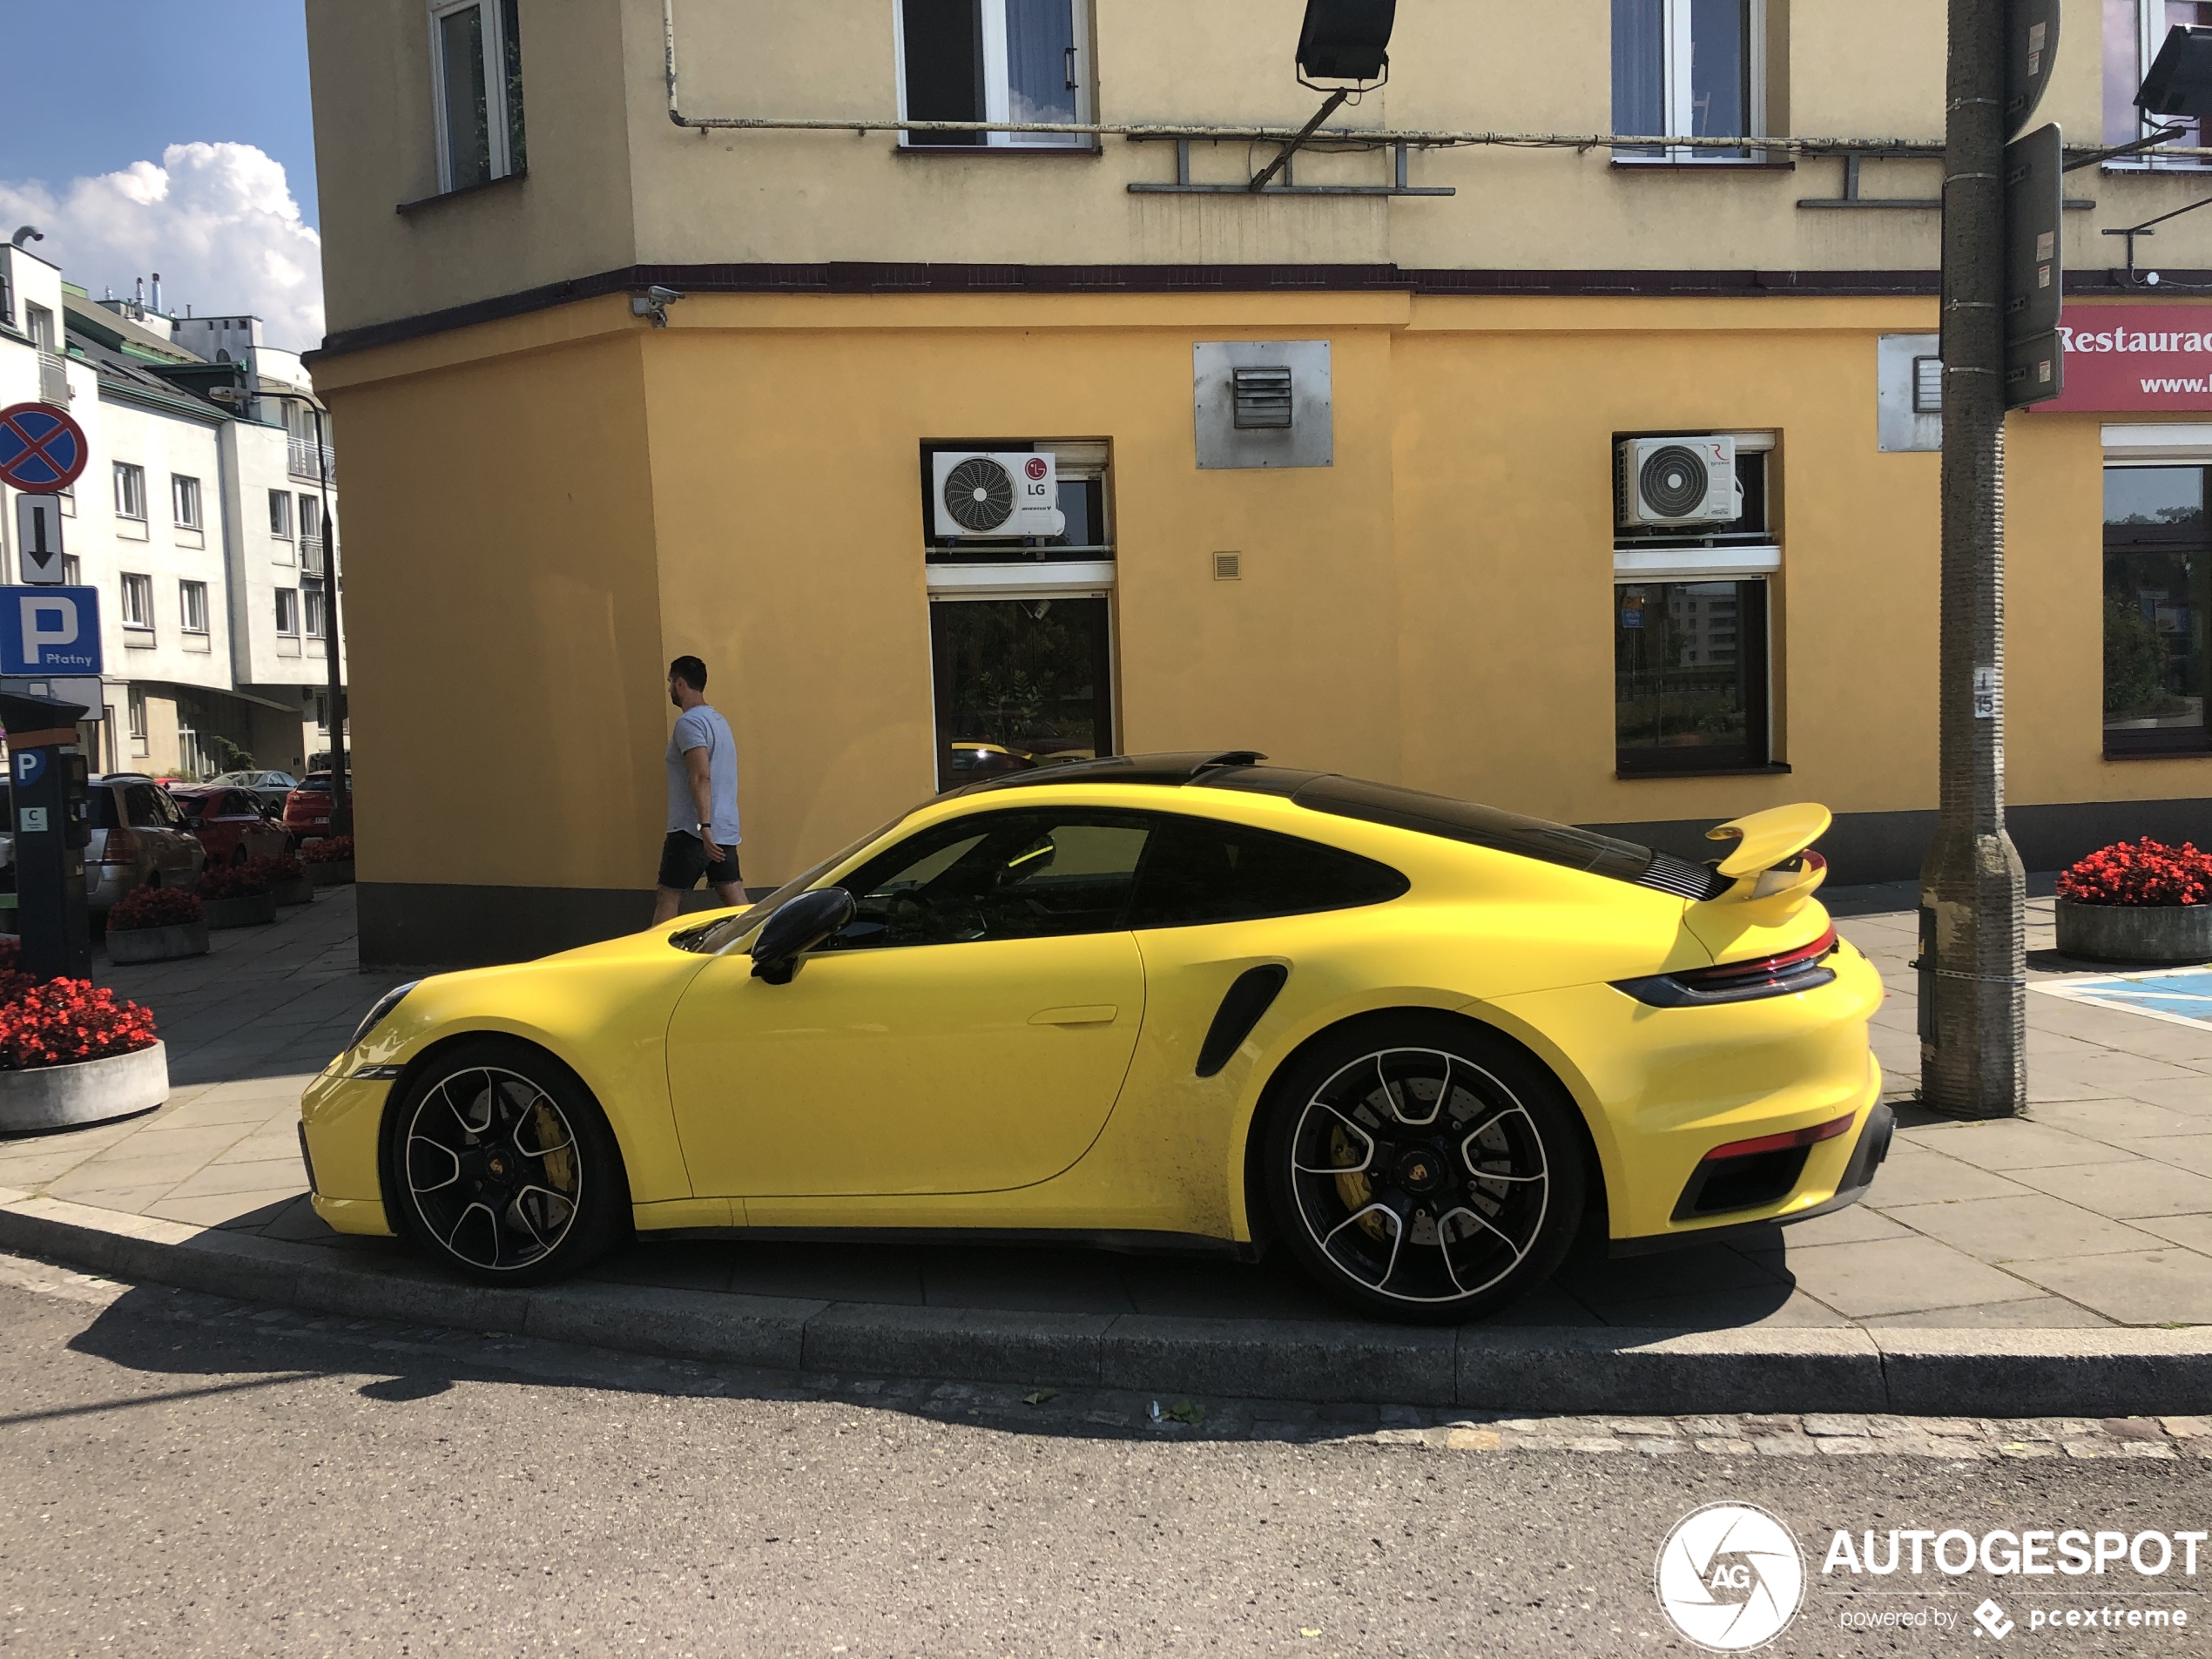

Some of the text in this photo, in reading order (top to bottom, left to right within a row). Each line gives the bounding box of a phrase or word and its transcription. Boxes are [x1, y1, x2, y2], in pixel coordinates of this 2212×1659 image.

[1028, 484, 1045, 496] LG
[19, 596, 79, 664] P
[17, 753, 37, 779] P
